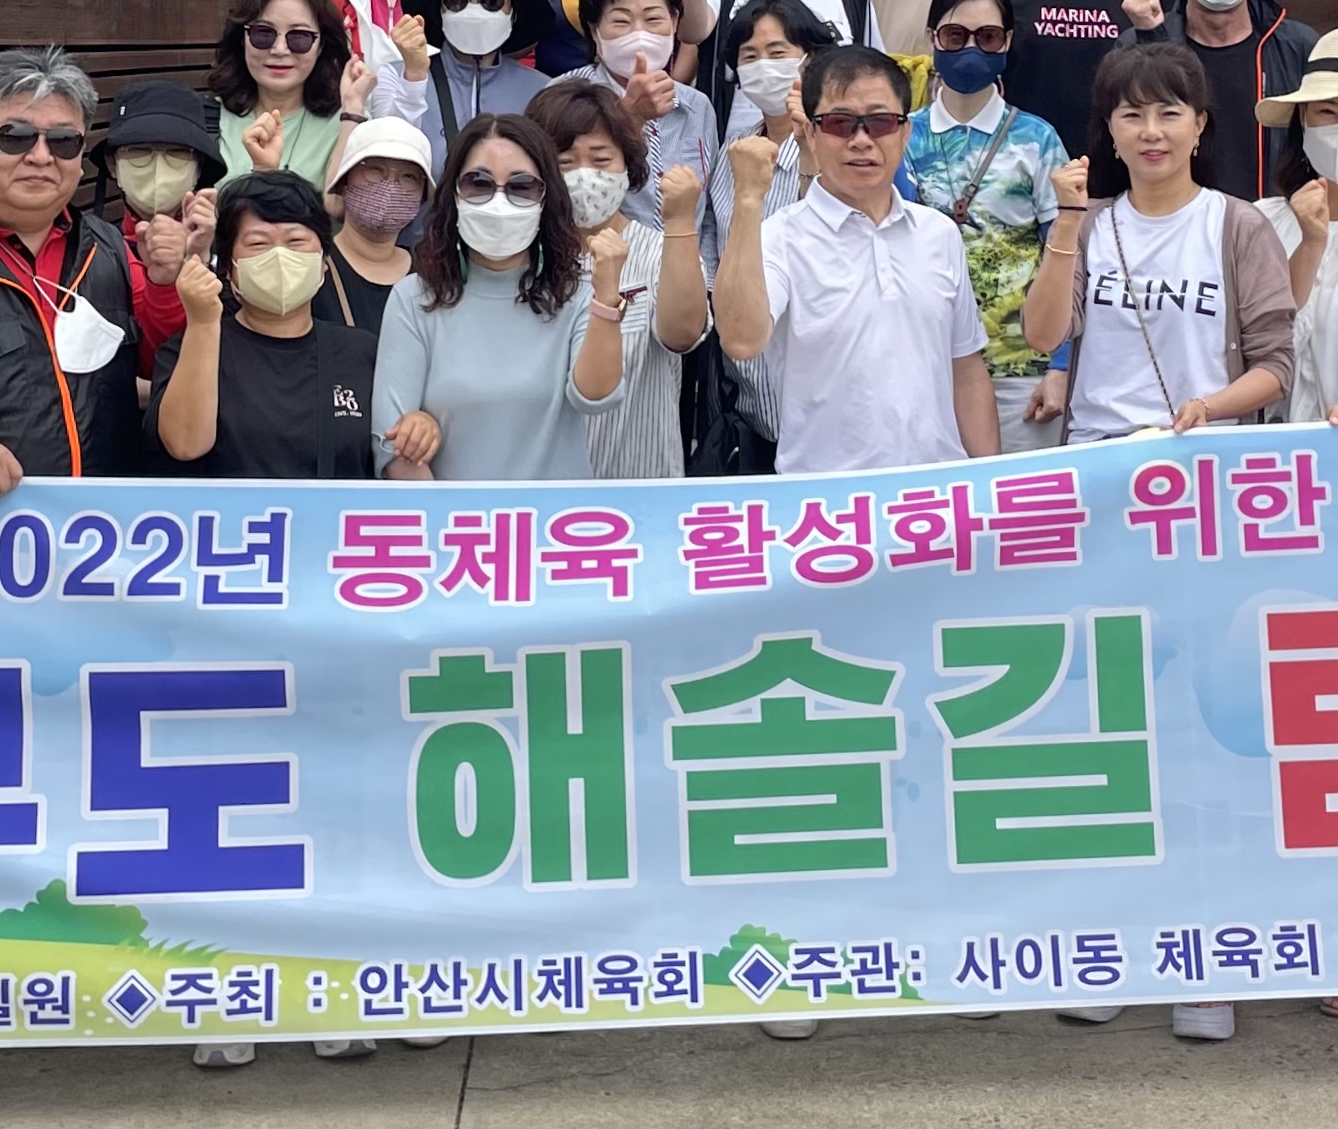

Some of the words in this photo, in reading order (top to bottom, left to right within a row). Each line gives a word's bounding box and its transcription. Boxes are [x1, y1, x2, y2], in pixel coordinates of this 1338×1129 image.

[1034, 21, 1119, 39] YACHTING
[1041, 7, 1111, 23] MARINA
[1087, 270, 1219, 317] ÉLINE
[331, 510, 639, 608] 동체육
[682, 470, 1087, 592] 활성화를
[1127, 452, 1327, 558] 위한
[407, 614, 1159, 885] 해솔길
[164, 967, 275, 1024] 주최
[360, 952, 701, 1017] 안산시체육회
[955, 932, 1125, 989] 사이동
[1156, 922, 1321, 979] 체육회
